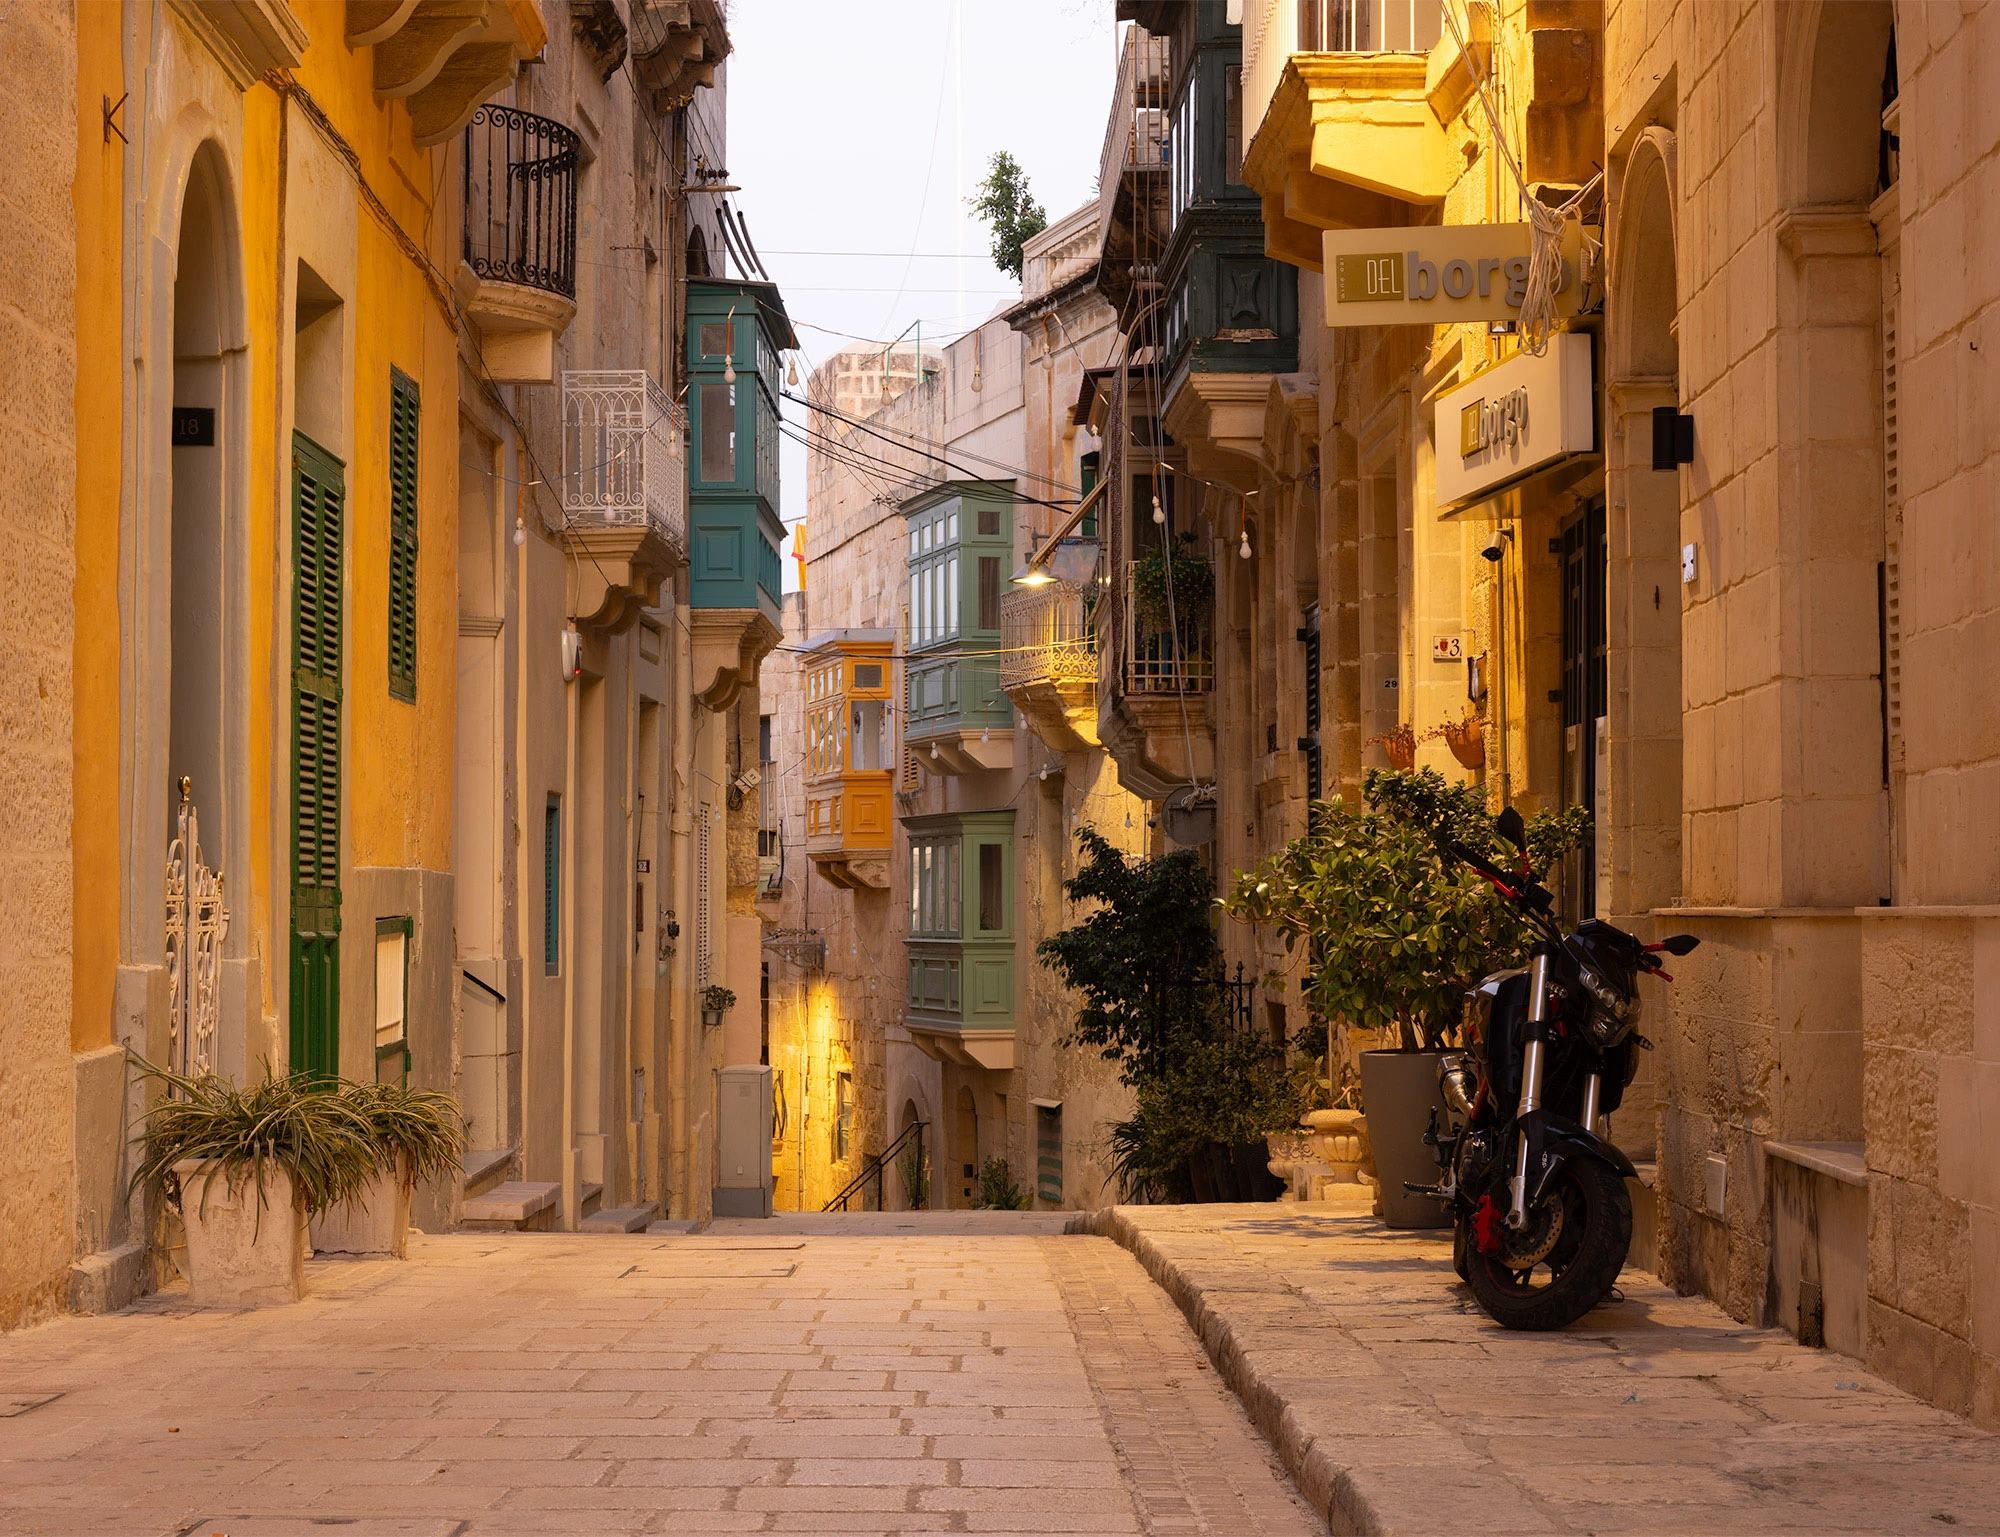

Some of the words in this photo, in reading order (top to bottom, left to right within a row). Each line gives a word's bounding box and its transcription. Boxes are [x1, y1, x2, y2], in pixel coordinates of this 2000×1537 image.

[1366, 258, 1402, 295] DEL
[179, 418, 199, 435] 18
[1479, 384, 1529, 450] borgo
[1384, 680, 1398, 688] 29
